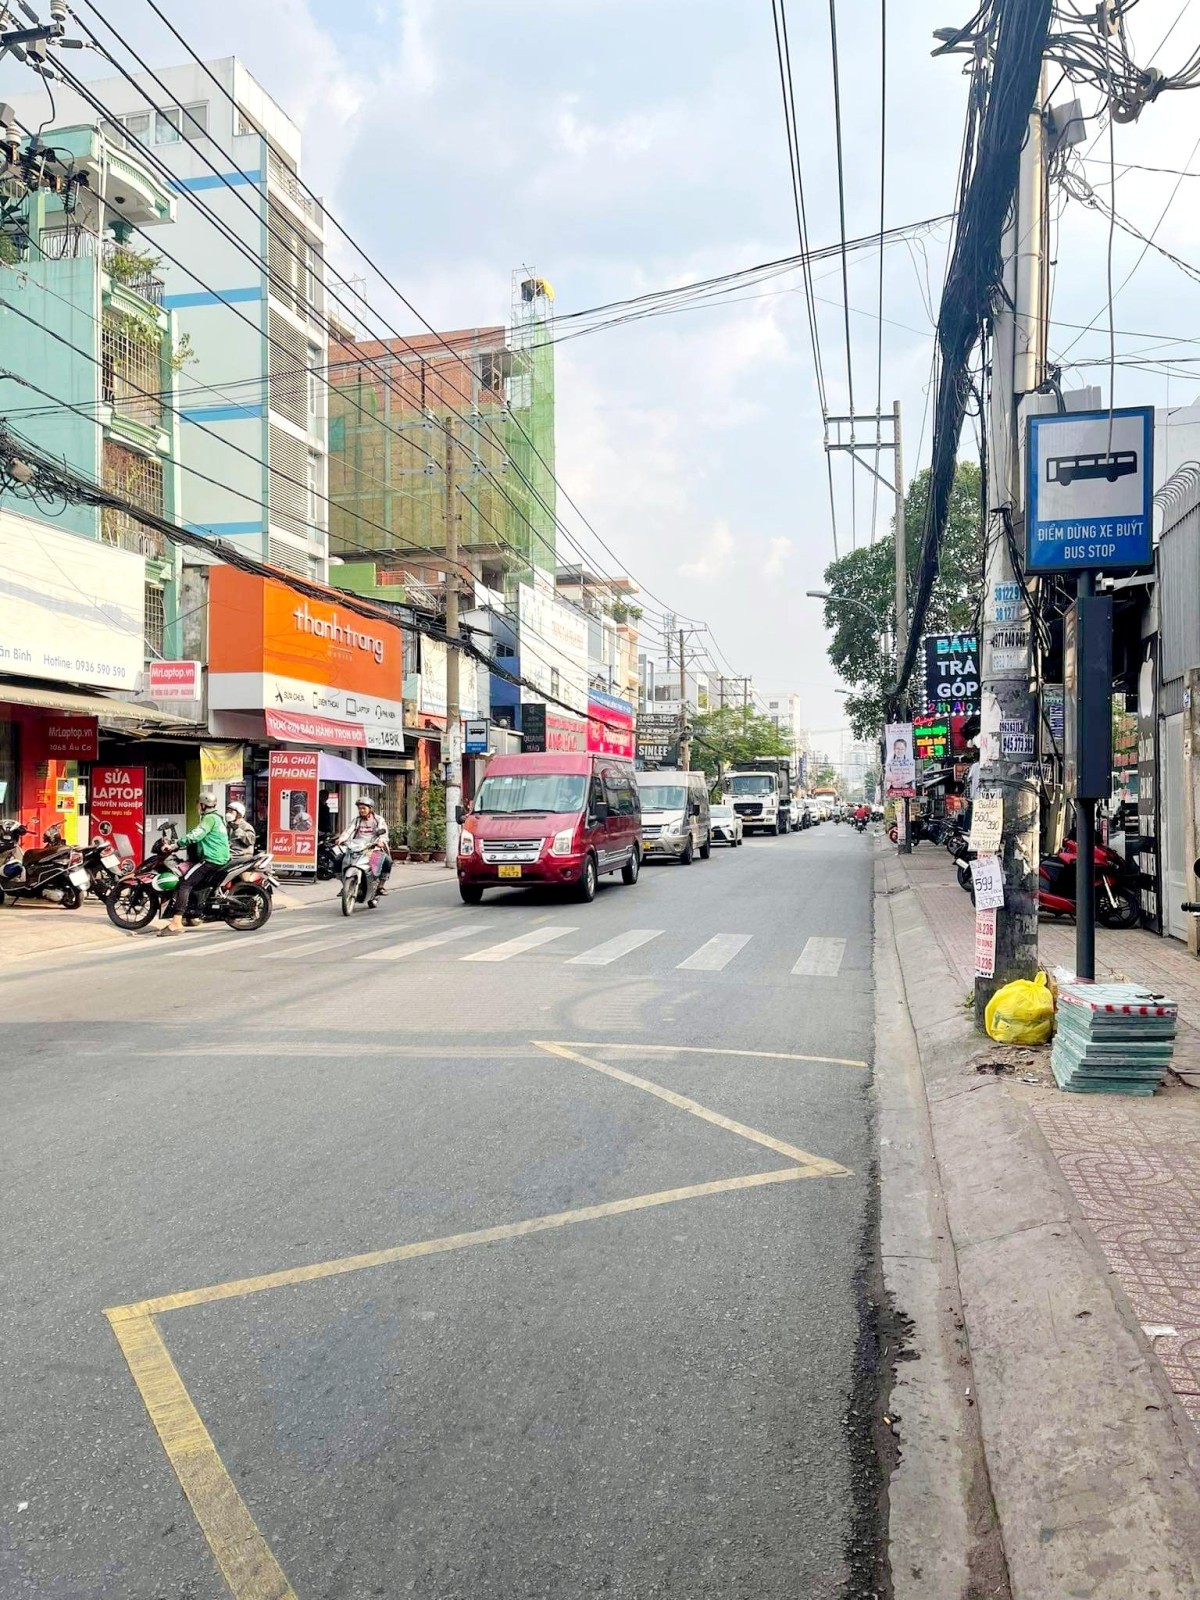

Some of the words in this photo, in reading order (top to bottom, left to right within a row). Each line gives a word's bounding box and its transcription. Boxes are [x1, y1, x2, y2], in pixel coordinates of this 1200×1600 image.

[1038, 524, 1063, 541] ĐIỂM
[1067, 523, 1096, 540] DỪNG
[1099, 524, 1113, 538] XE
[1116, 520, 1144, 537] BUÝT
[1064, 545, 1085, 559] BUS
[1088, 544, 1116, 558] STOP
[937, 635, 977, 654] BÁN
[13, 648, 32, 663] Bình
[43, 654, 73, 670] Hotline:
[75, 660, 95, 672] 0936
[97, 663, 111, 675] 590
[113, 667, 126, 678] 590
[937, 655, 977, 676] TRẢ
[151, 667, 194, 680] MrLaptop.vn
[937, 677, 979, 698] GÓP
[48, 726, 93, 740] MrLaptop.vn
[919, 745, 944, 757] LED
[271, 754, 289, 764] SỬA
[291, 755, 317, 765] CHỮA
[104, 768, 131, 784] SỬA
[270, 768, 317, 779] IPHONE
[92, 786, 143, 800] LAPTOP
[92, 800, 118, 808] CHUYÊN
[118, 801, 143, 810] NGHIỆP
[295, 842, 311, 854] 12
[975, 876, 993, 892] 599
